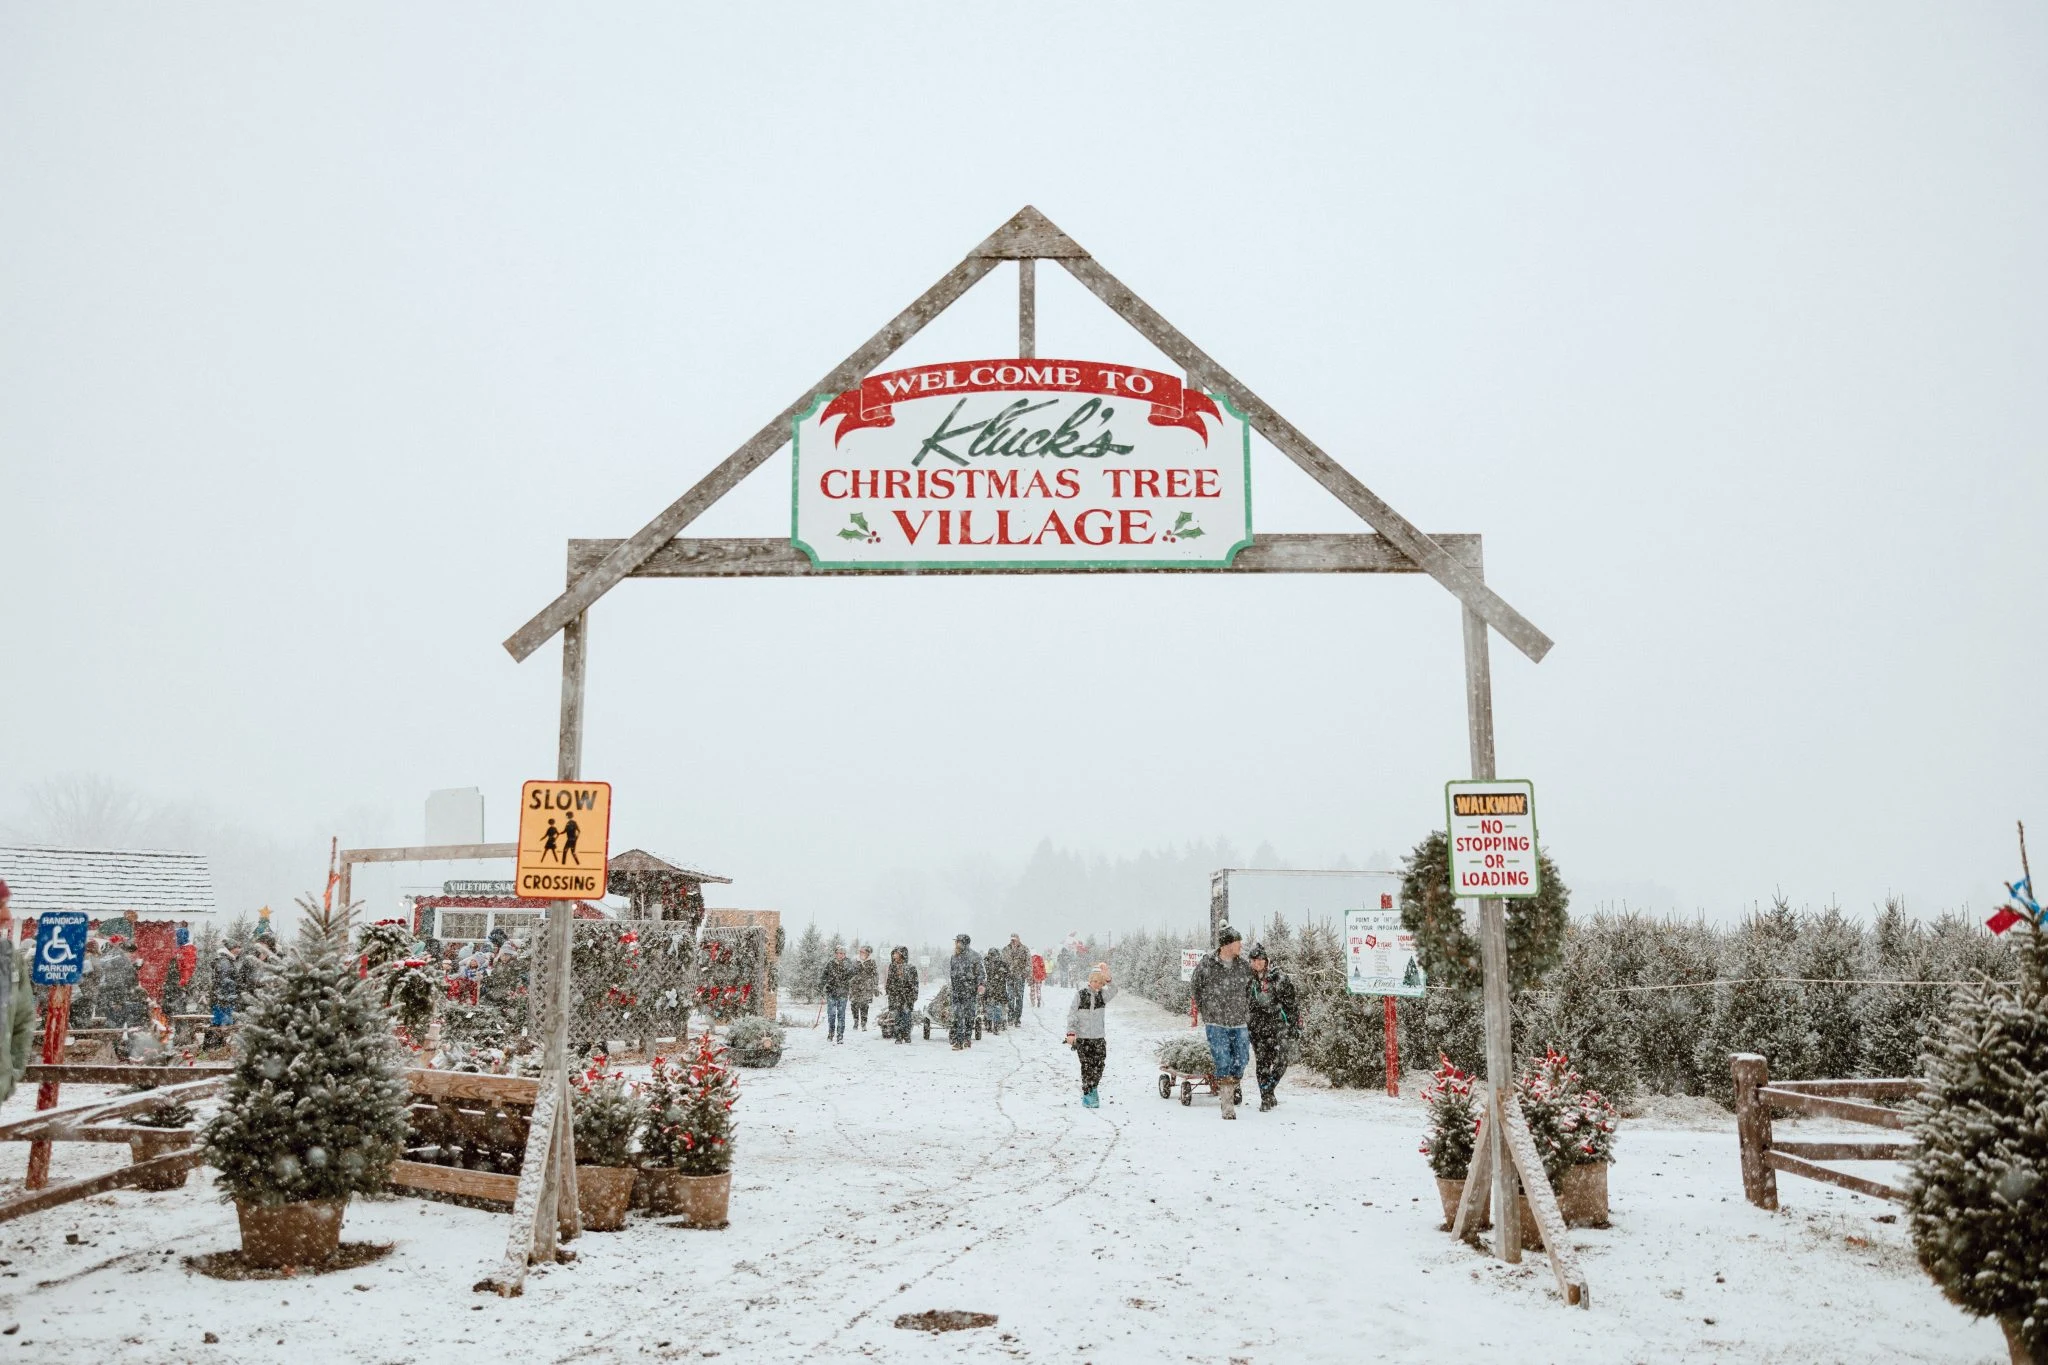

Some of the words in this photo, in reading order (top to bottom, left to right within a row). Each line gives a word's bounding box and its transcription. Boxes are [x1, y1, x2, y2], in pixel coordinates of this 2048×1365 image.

[881, 366, 1081, 397] WELCOME
[1103, 372, 1155, 395] TO
[911, 396, 1135, 467] Kluck's
[819, 468, 1081, 499] CHRISTMAS
[1102, 468, 1223, 499] TREE
[891, 508, 1158, 546] VILLAGE
[529, 788, 598, 811] SLOW
[1456, 795, 1525, 814] WALKWAY
[1481, 819, 1503, 834] NO
[1456, 836, 1530, 852] STOPPING
[1484, 854, 1505, 869] OR
[450, 882, 492, 891] YULETIDE
[494, 882, 516, 891] SNAC
[523, 874, 596, 891] CROSSING
[1462, 871, 1529, 886] LOADING
[42, 916, 85, 925] HANDICAP
[38, 964, 77, 972] PARKING
[46, 972, 69, 980] ONLY
